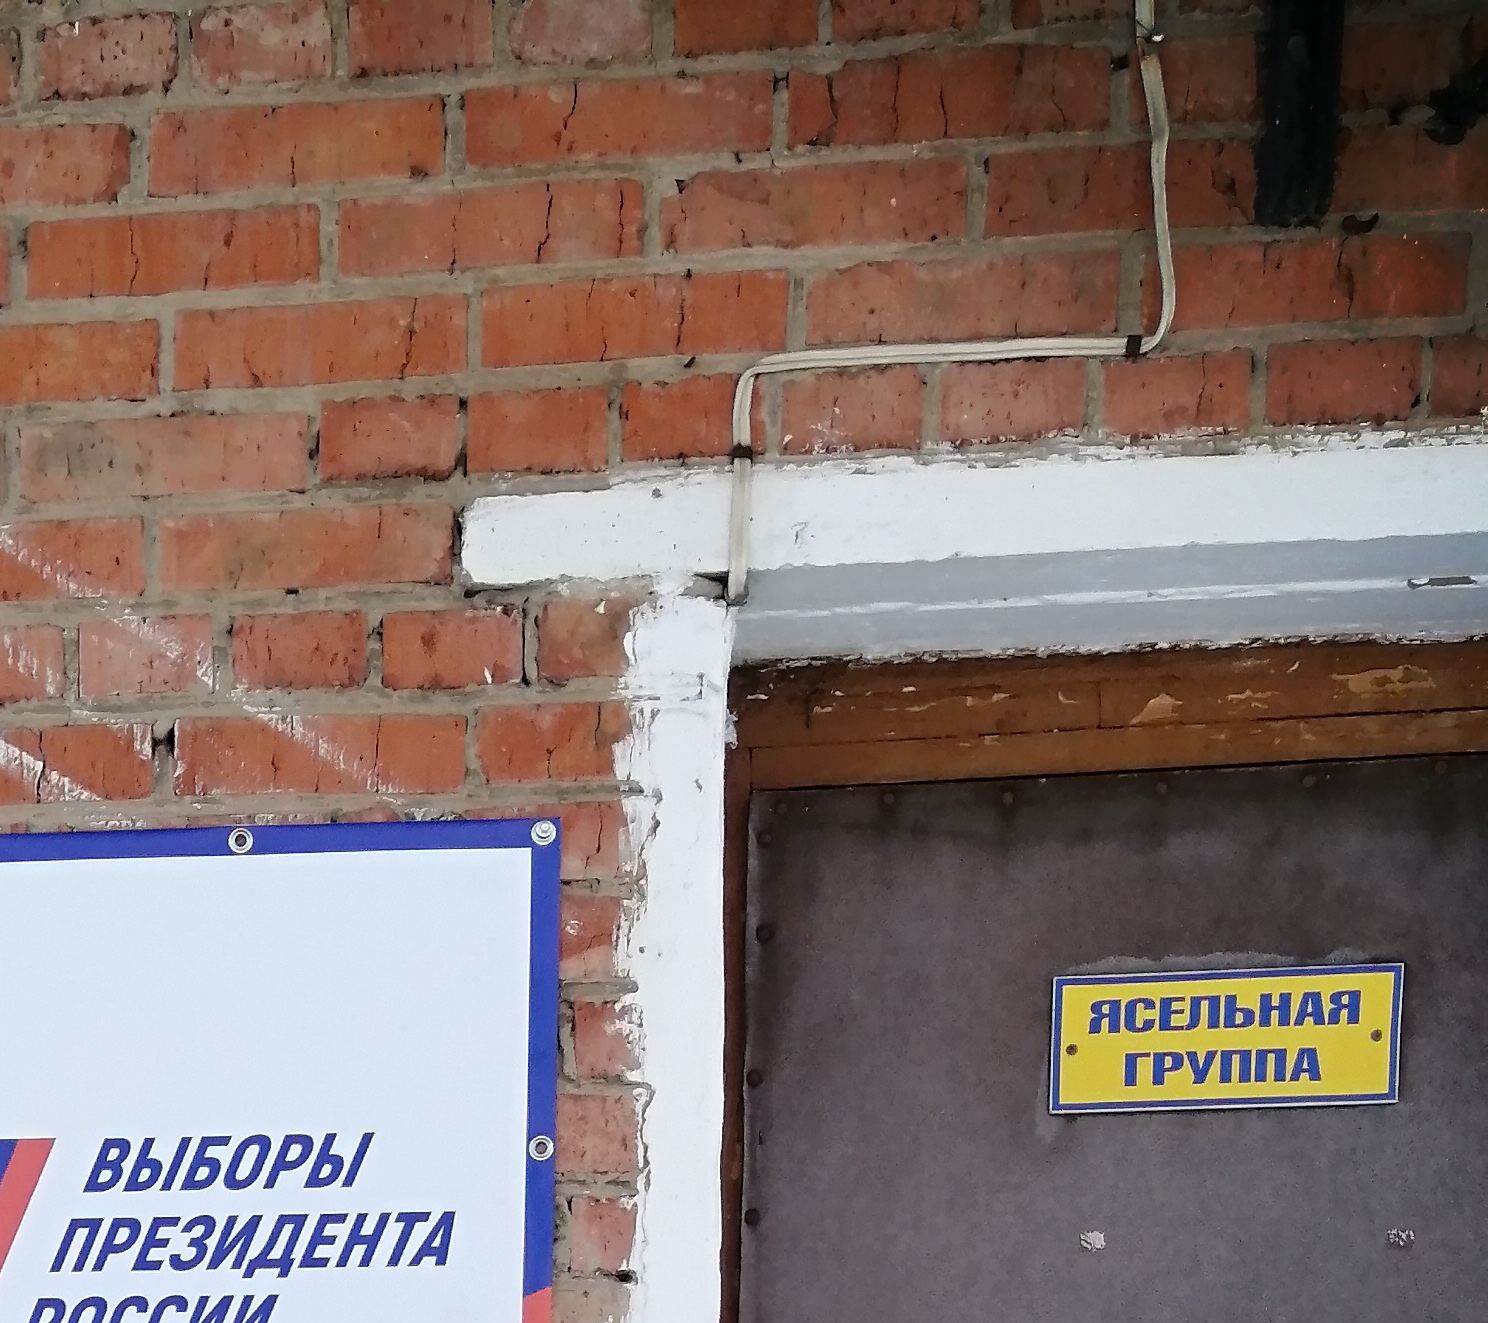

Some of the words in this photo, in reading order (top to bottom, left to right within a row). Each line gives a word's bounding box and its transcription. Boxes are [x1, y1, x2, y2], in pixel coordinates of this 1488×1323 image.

[1088, 989, 1362, 1035] ЯСЕЛЬНАЯ
[1123, 1047, 1322, 1087] ГРУППА
[82, 1131, 376, 1194] ВЫБОРЫ
[49, 1210, 457, 1279] ПРЕЗИДЕНТА
